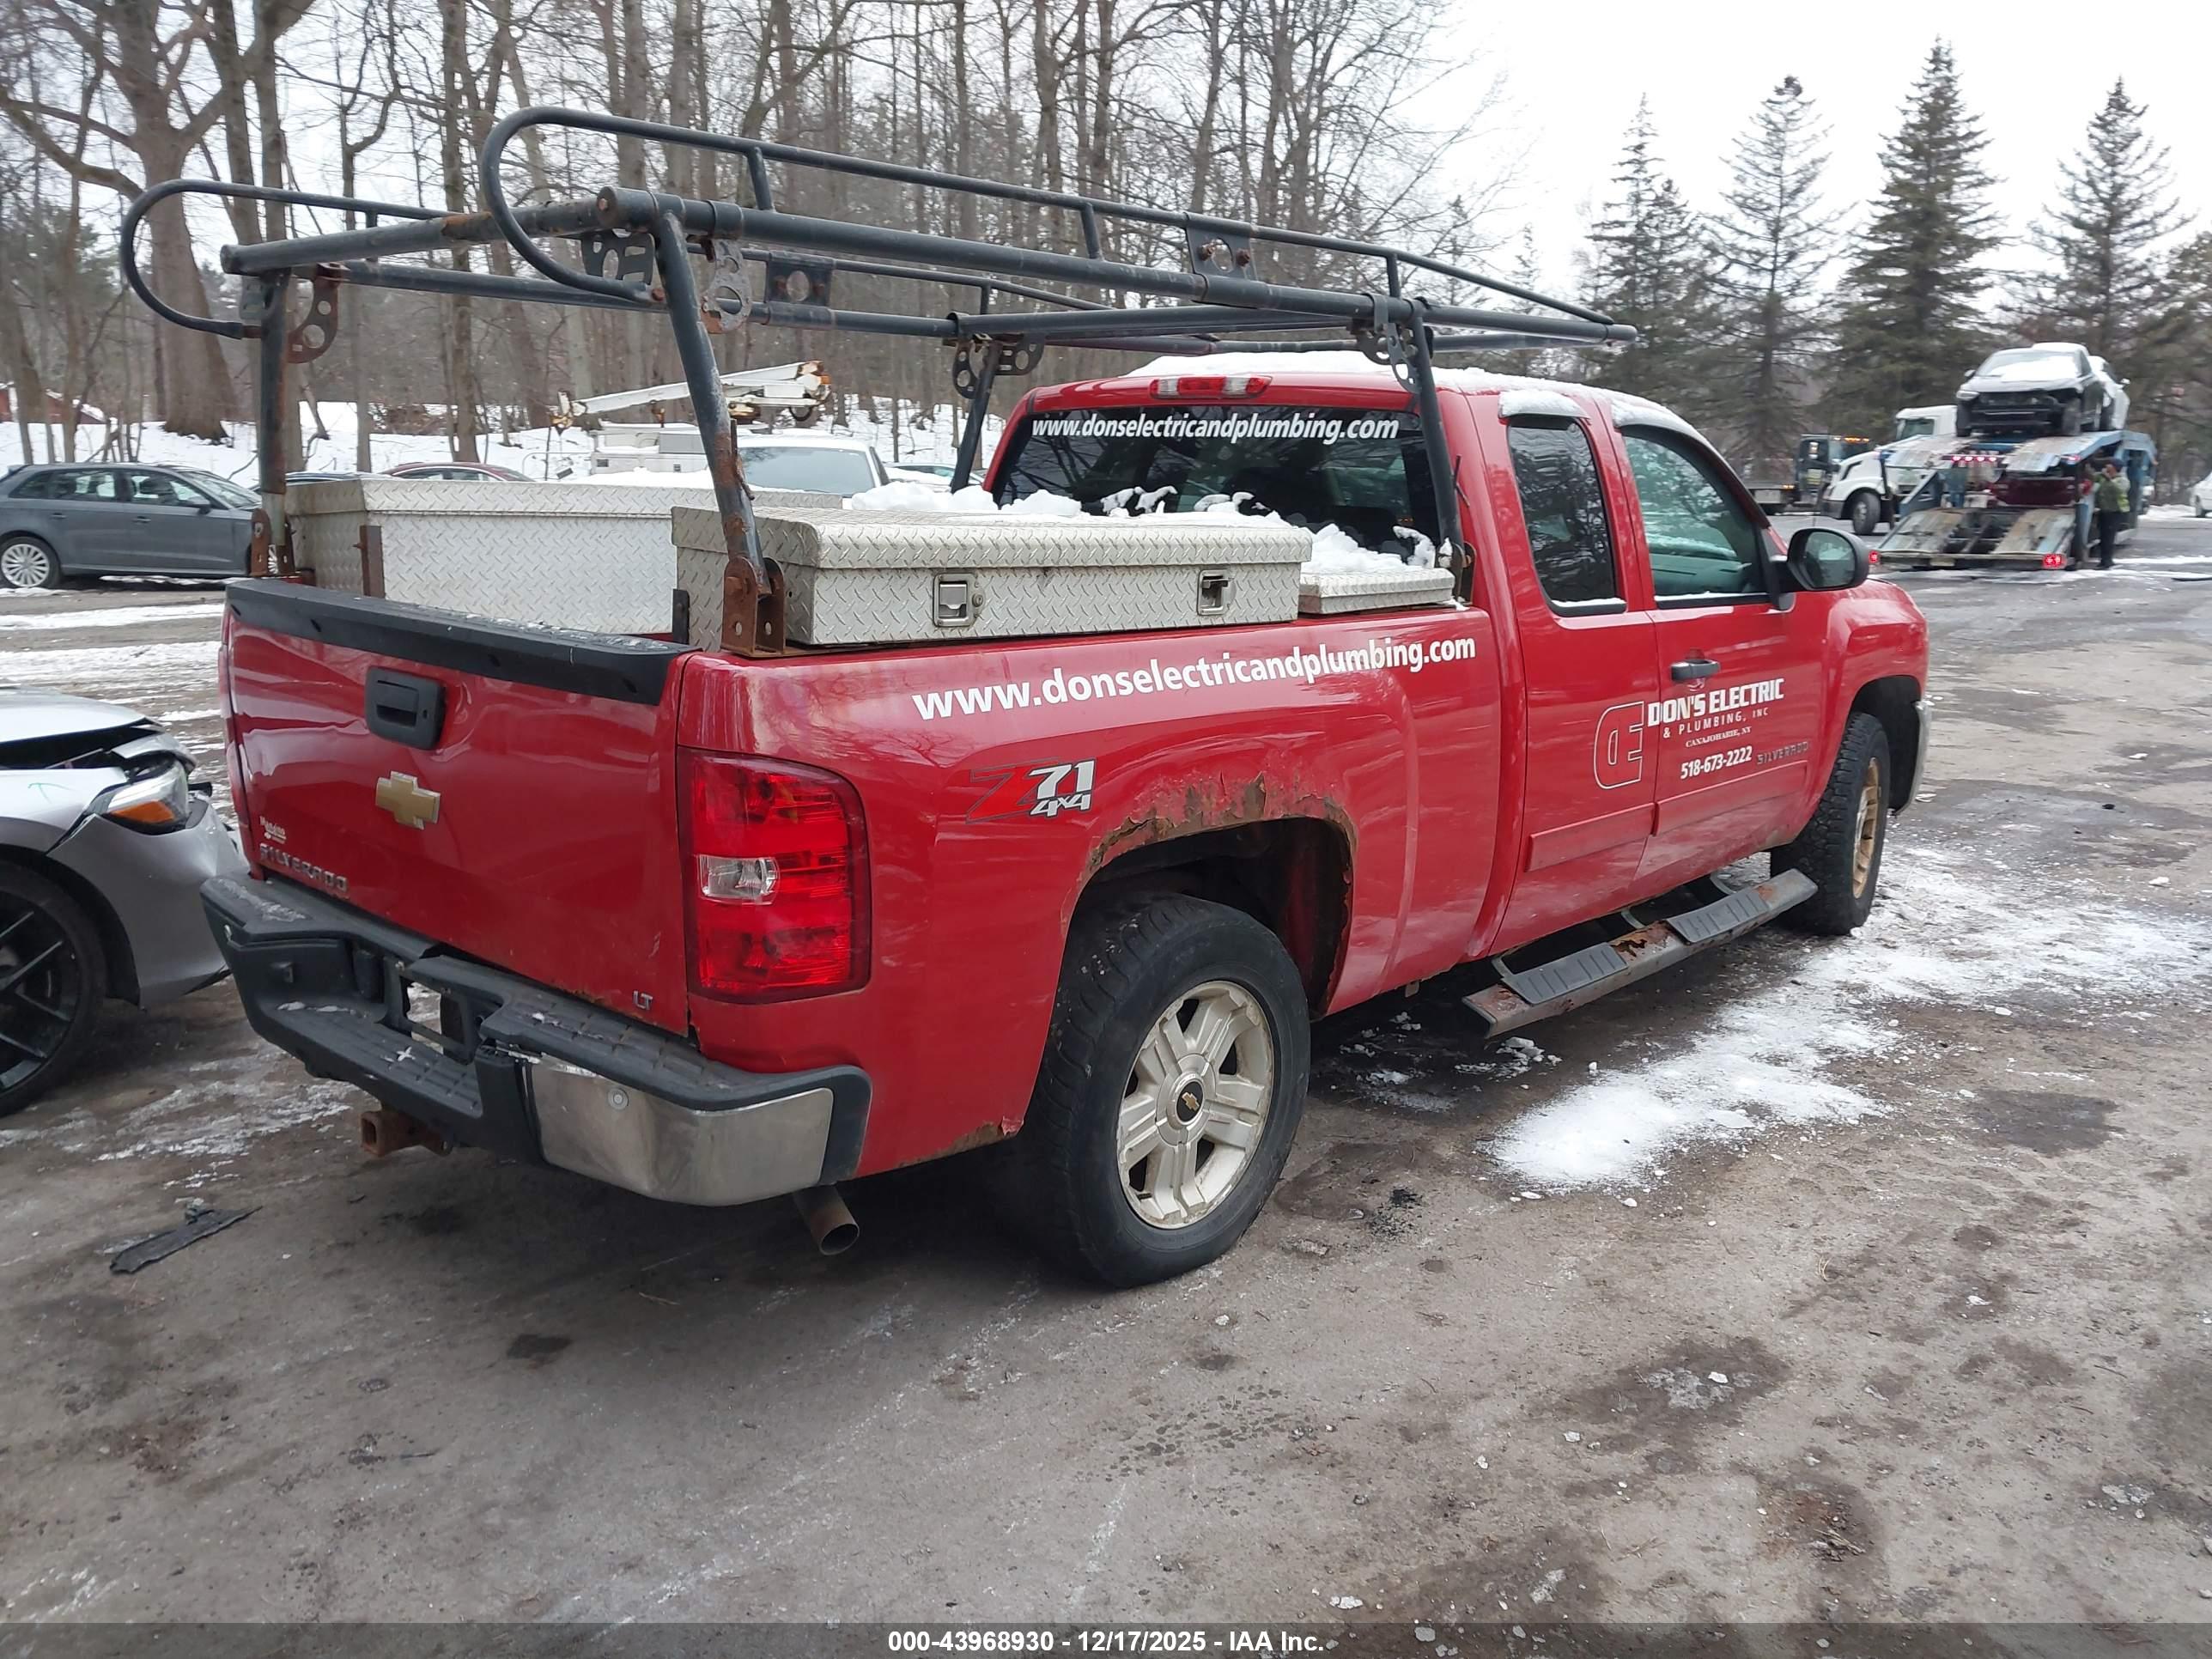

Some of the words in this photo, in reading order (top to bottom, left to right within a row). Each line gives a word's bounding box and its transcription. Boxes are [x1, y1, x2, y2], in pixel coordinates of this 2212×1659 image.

[1031, 412, 1399, 444] www.donselectricandplumbing.com
[912, 635, 1476, 720] www.donselectricandplumbing.com
[1648, 692, 1705, 727] DON'S
[1708, 678, 1785, 712] ELECTRIC
[1662, 727, 1671, 738] &
[1753, 707, 1769, 719] INC
[1680, 744, 1753, 780] 518-673-2222
[633, 990, 653, 1011] LT
